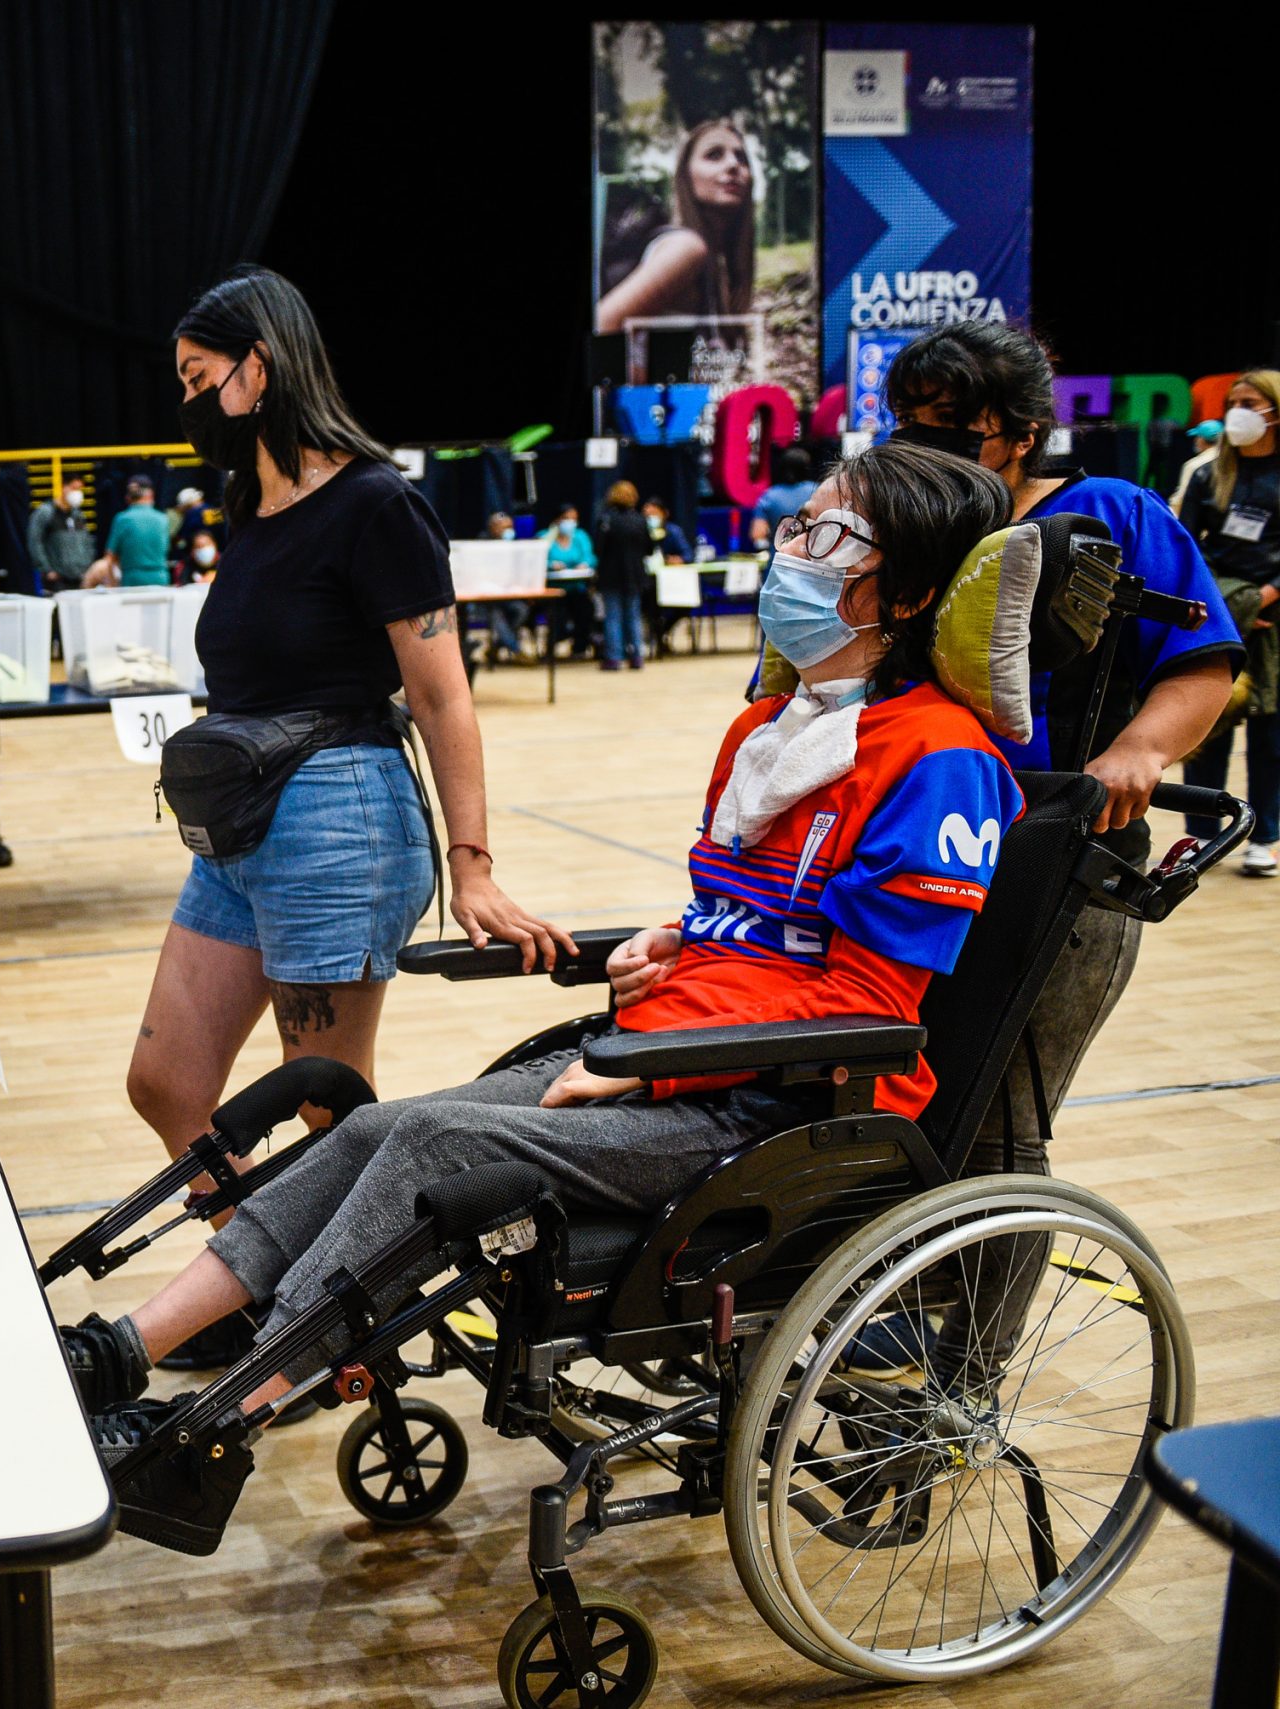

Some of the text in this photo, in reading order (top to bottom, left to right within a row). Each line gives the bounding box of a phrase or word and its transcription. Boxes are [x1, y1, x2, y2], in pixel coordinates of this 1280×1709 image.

[851, 271, 978, 301] LA UFRO
[851, 298, 1007, 329] COMIENZA
[139, 712, 166, 748] 30
[919, 882, 957, 895] UNDER
[608, 1421, 645, 1448] Netti
